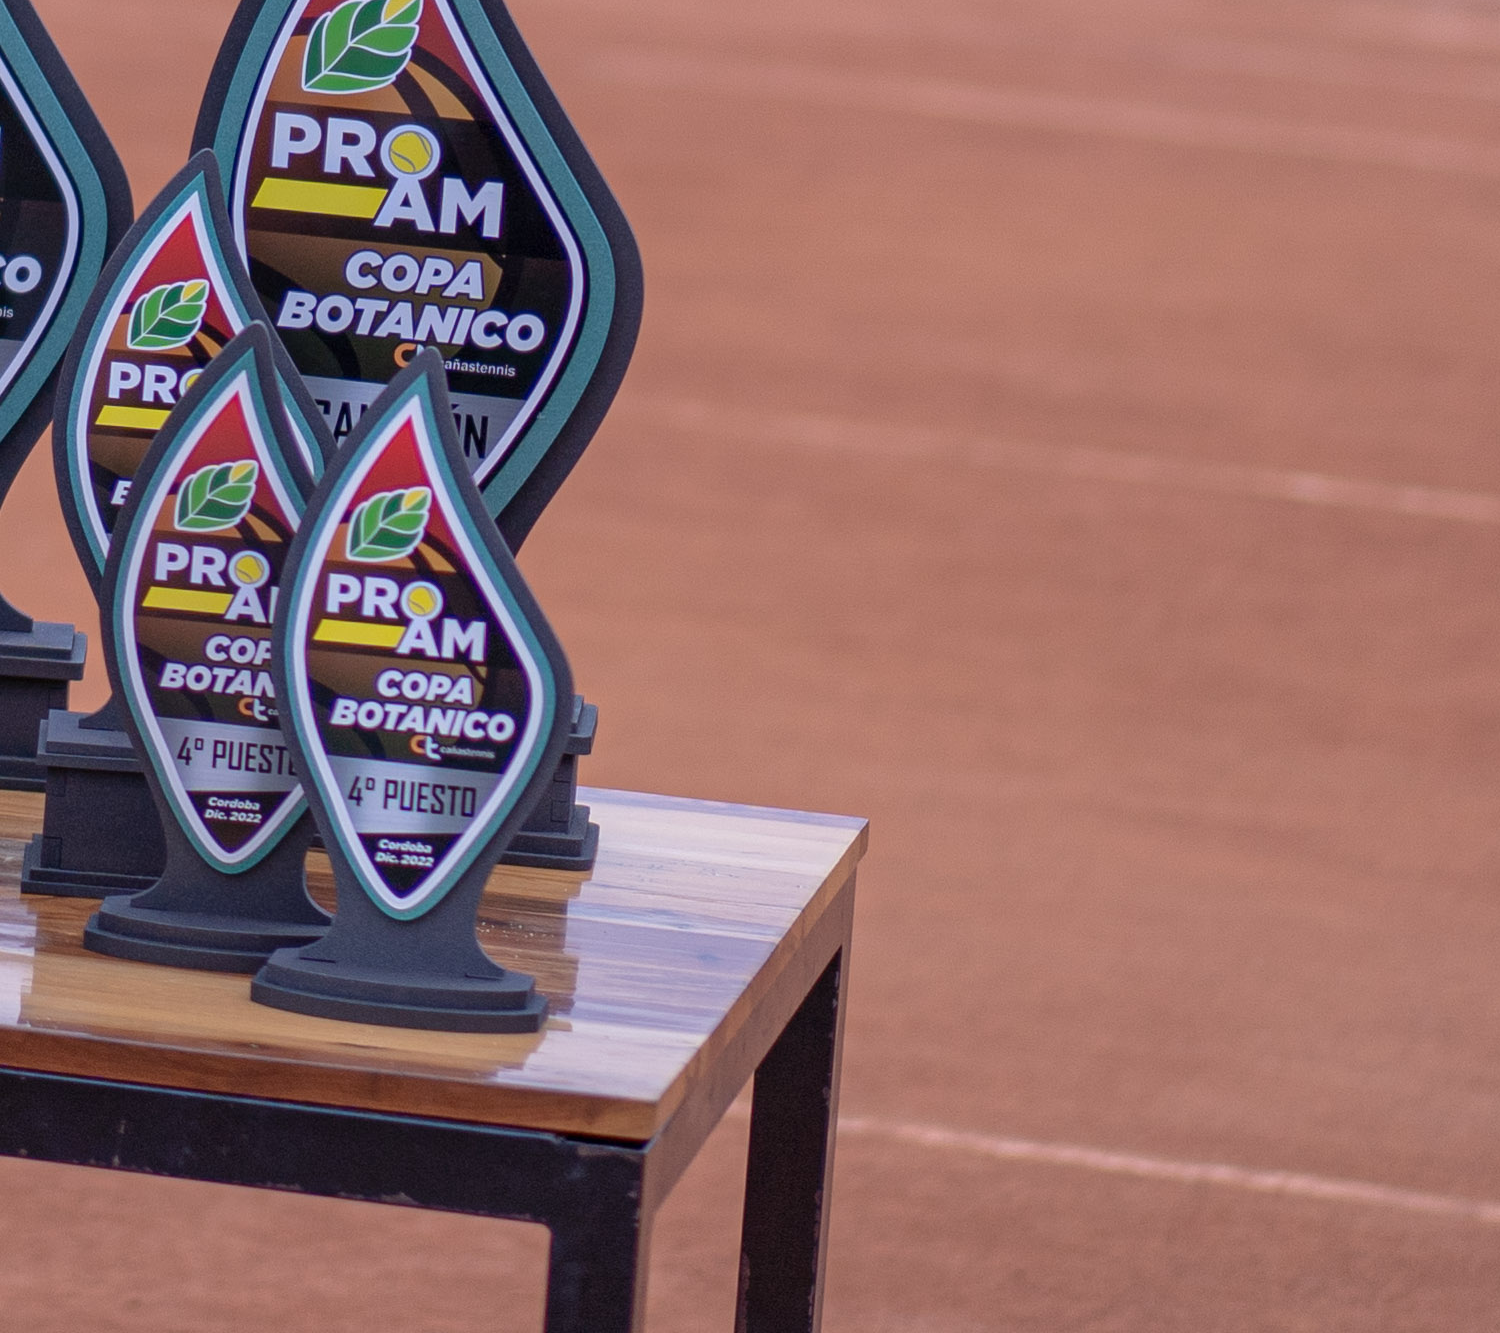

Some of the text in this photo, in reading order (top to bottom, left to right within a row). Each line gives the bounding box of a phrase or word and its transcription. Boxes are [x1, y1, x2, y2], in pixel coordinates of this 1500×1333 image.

[271, 112, 441, 180] PRO
[373, 176, 504, 239] AM
[345, 249, 484, 300] COPA
[276, 290, 547, 353] BOTANICO
[154, 542, 270, 588] PRO
[326, 573, 443, 621] PRO
[205, 635, 272, 665] COP
[396, 617, 487, 662] AM
[160, 662, 276, 698] BOTAN
[376, 669, 473, 705] COPA
[330, 698, 515, 741] BOTANICO
[204, 808, 262, 823] Dic. 2022
[207, 796, 260, 811] Cordoba
[383, 779, 477, 818] PUESTO
[375, 851, 434, 867] Dic. 2022
[378, 839, 432, 854] Cordoba
